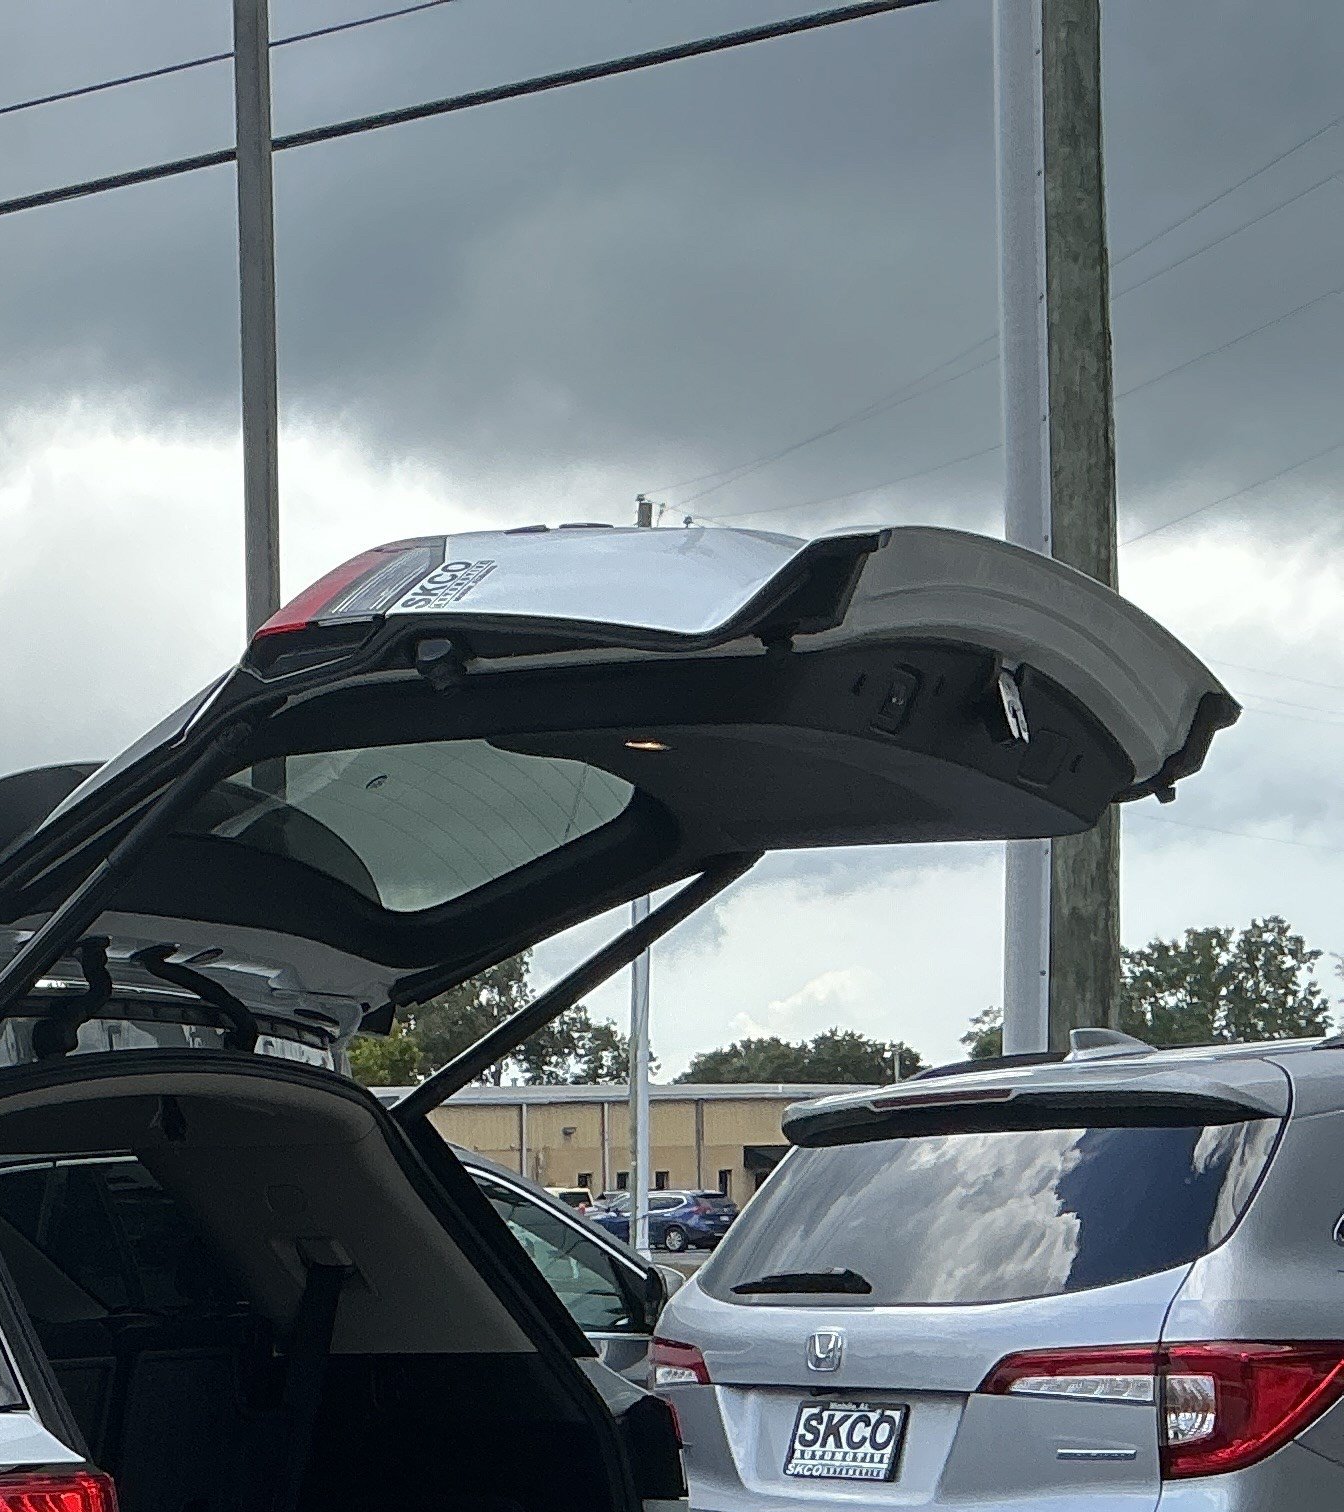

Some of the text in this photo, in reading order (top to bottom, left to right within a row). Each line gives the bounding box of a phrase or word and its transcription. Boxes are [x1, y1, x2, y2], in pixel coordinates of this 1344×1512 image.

[400, 561, 473, 610] SKCO
[798, 1412, 897, 1451] SKCO
[793, 1449, 891, 1463] AUTOMOTIVE
[785, 1463, 823, 1476] SKCO
